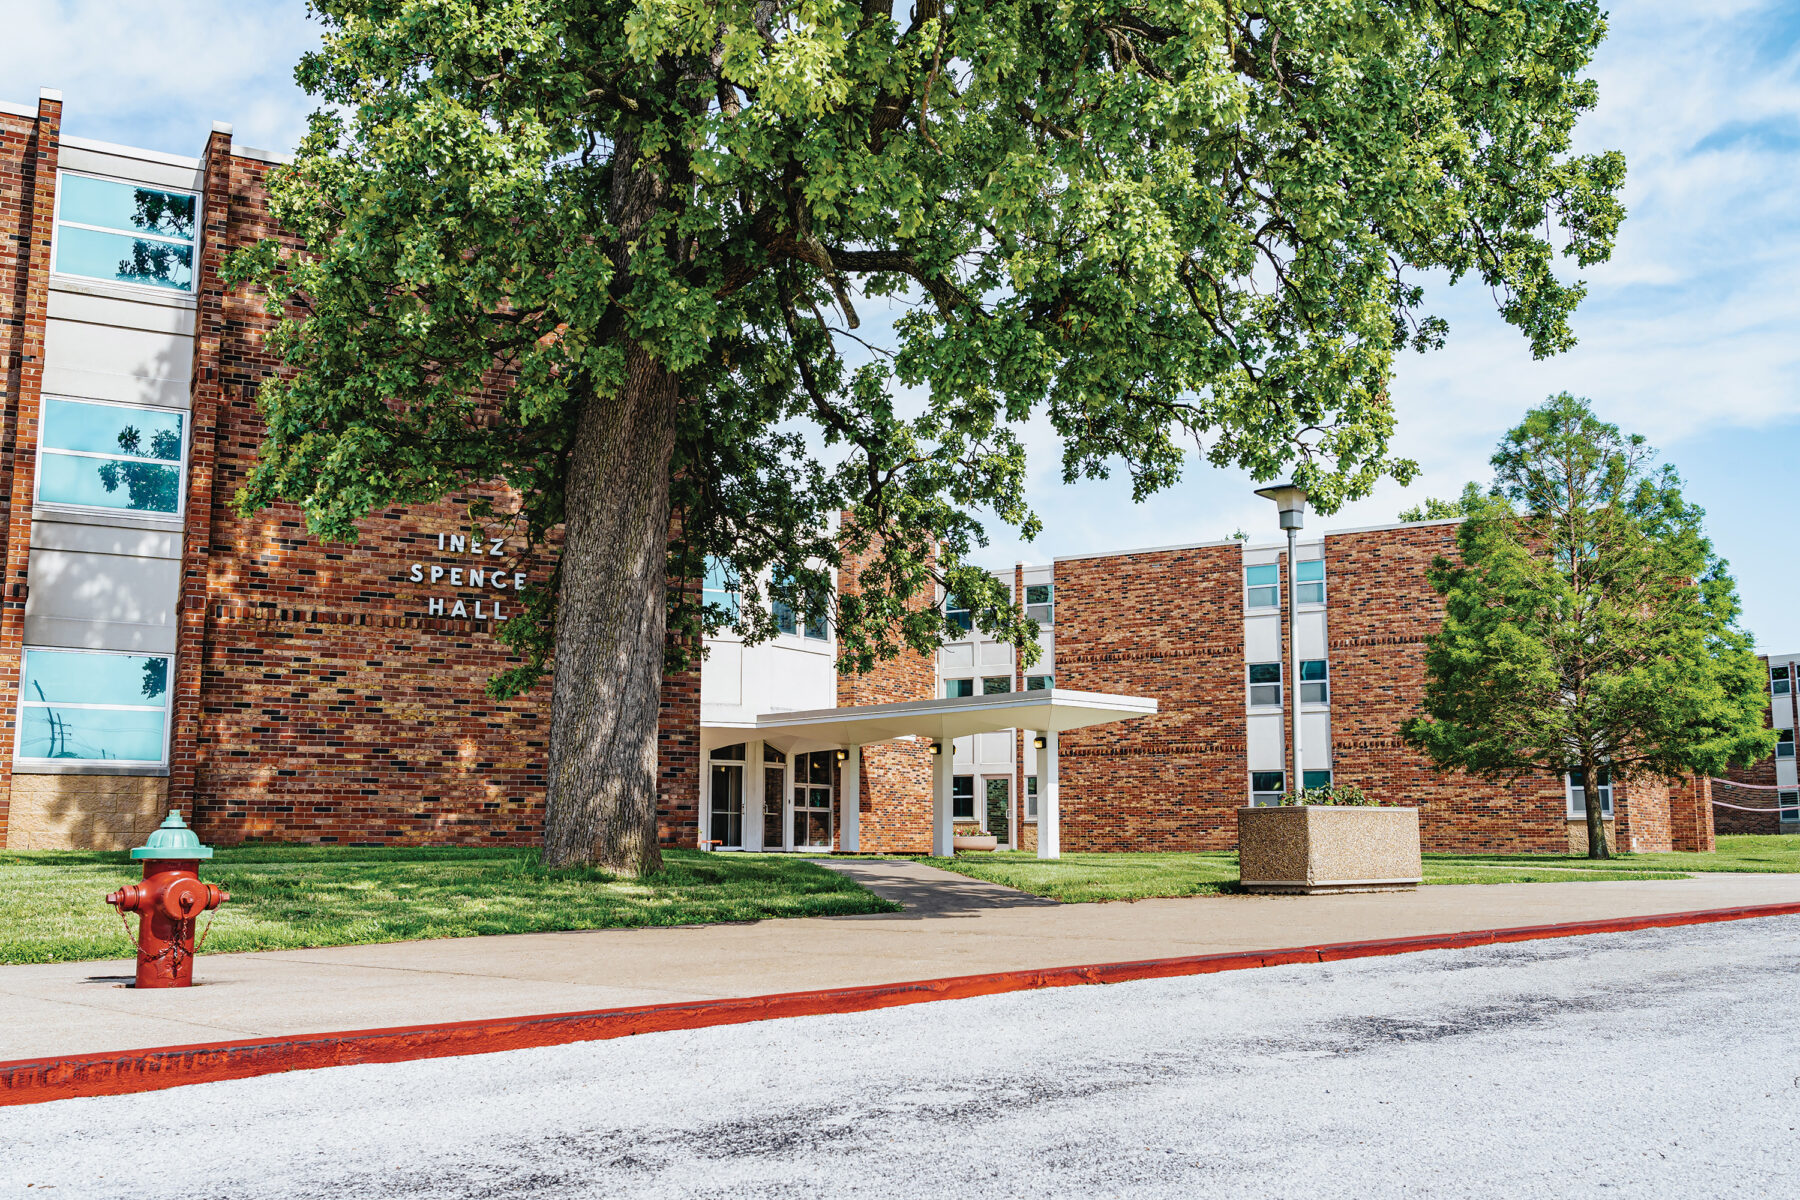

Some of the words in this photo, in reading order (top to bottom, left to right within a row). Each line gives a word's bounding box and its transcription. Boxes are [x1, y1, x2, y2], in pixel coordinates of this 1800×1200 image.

[438, 532, 504, 556] INEZ
[409, 563, 527, 591] SPENCE
[428, 597, 508, 620] HALL
